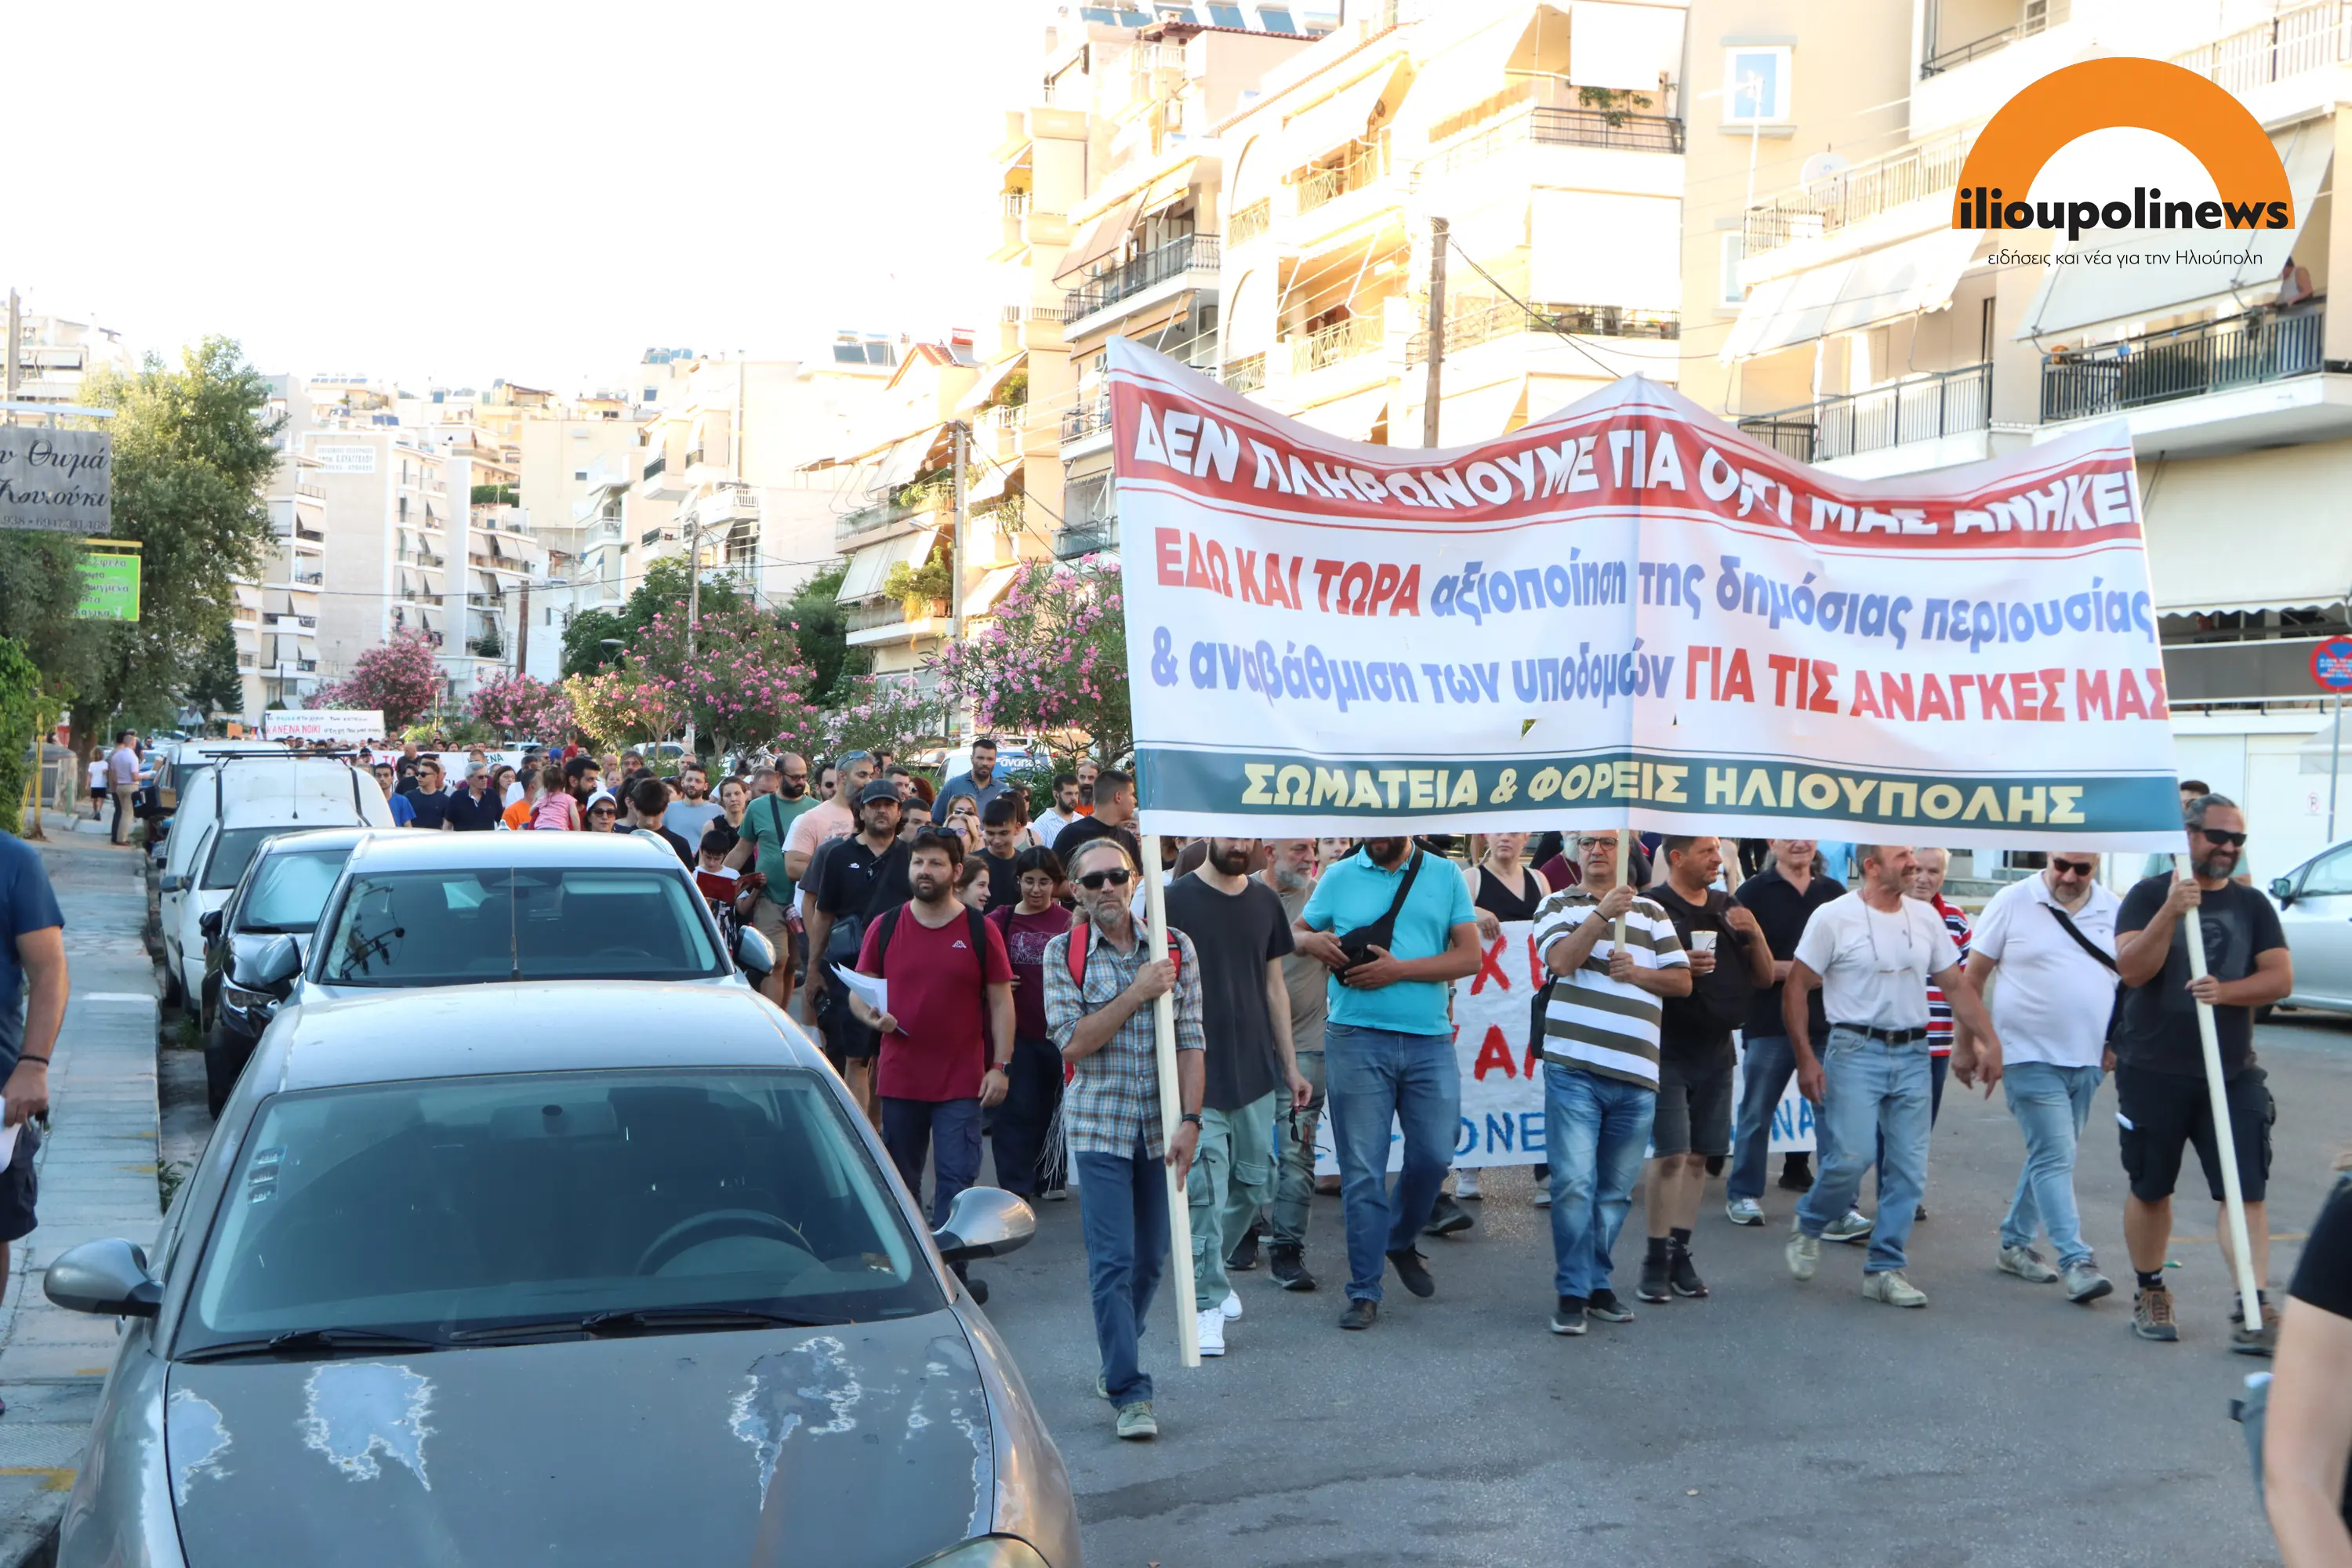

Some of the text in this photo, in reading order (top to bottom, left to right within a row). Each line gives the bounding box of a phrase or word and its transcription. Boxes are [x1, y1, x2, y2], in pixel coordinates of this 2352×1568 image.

[1134, 401, 1240, 477] ΔΕΝ
[1253, 435, 1597, 510] ΠΛΗΡΩΝΟΥΜΕ
[1609, 429, 1686, 492] ΓΙΑ
[1809, 492, 1938, 535] ΜΑΣ
[1953, 470, 2140, 534] ΑΝΗΚΕΙ
[1155, 527, 2155, 653] ΕΔΩ ΚΑΙ ΤΩΡΑ αξιοποίηση της δημόσιας περιουσίας
[1151, 625, 2170, 722] & αναβάθμιση των υποδομών ΓΙΑ ΤΙΣ ΑΝΑΓΚΕΣ ΜΑΣ
[1241, 760, 2086, 825] ΣΩΜΑΤΕΙΑ & ΦΟΡΕΙΣ ΗΛΙΟΥΠΟΛΗΣ
